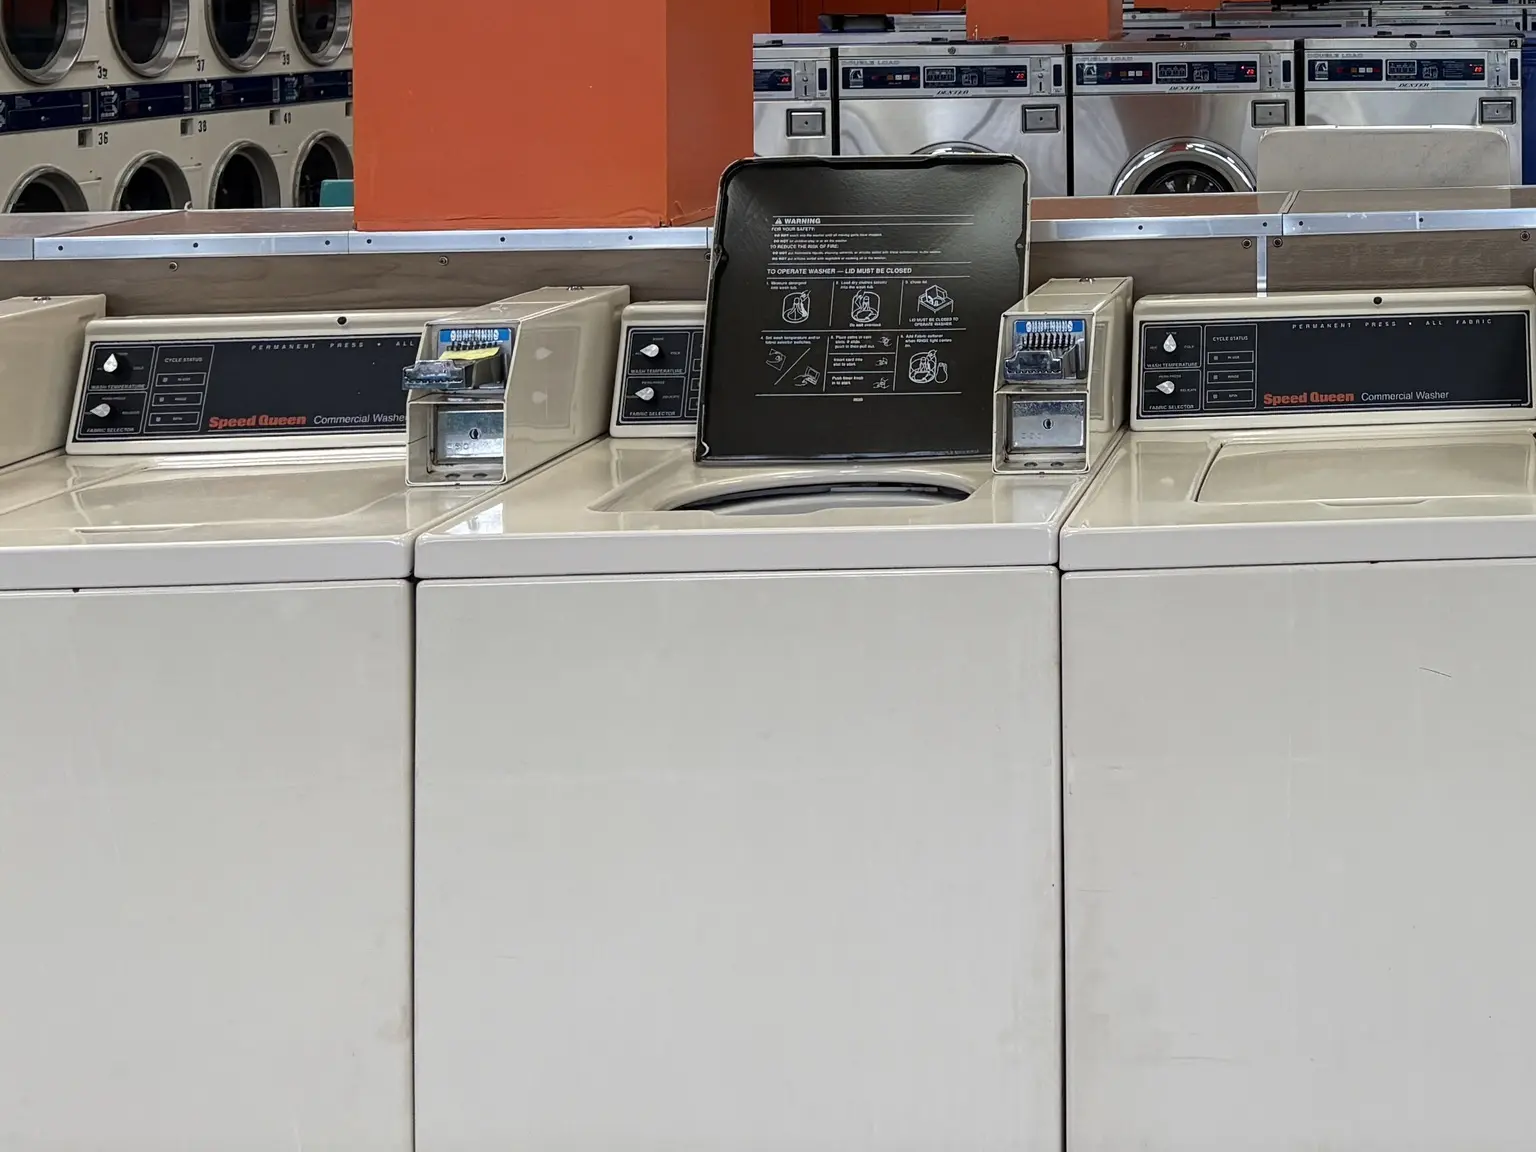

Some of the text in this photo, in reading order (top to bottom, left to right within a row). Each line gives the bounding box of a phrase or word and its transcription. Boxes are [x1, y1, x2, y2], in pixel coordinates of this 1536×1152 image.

[283, 53, 290, 66] 39
[197, 60, 204, 72] 37
[284, 112, 291, 124] 40
[198, 120, 207, 132] 38
[99, 132, 108, 145] 36
[252, 343, 316, 351] PERMANENT
[1263, 390, 1449, 407] Speed Queen Commercial Washer
[208, 415, 255, 430] Speed
[258, 415, 306, 426] Queen
[313, 414, 369, 425] Commercial
